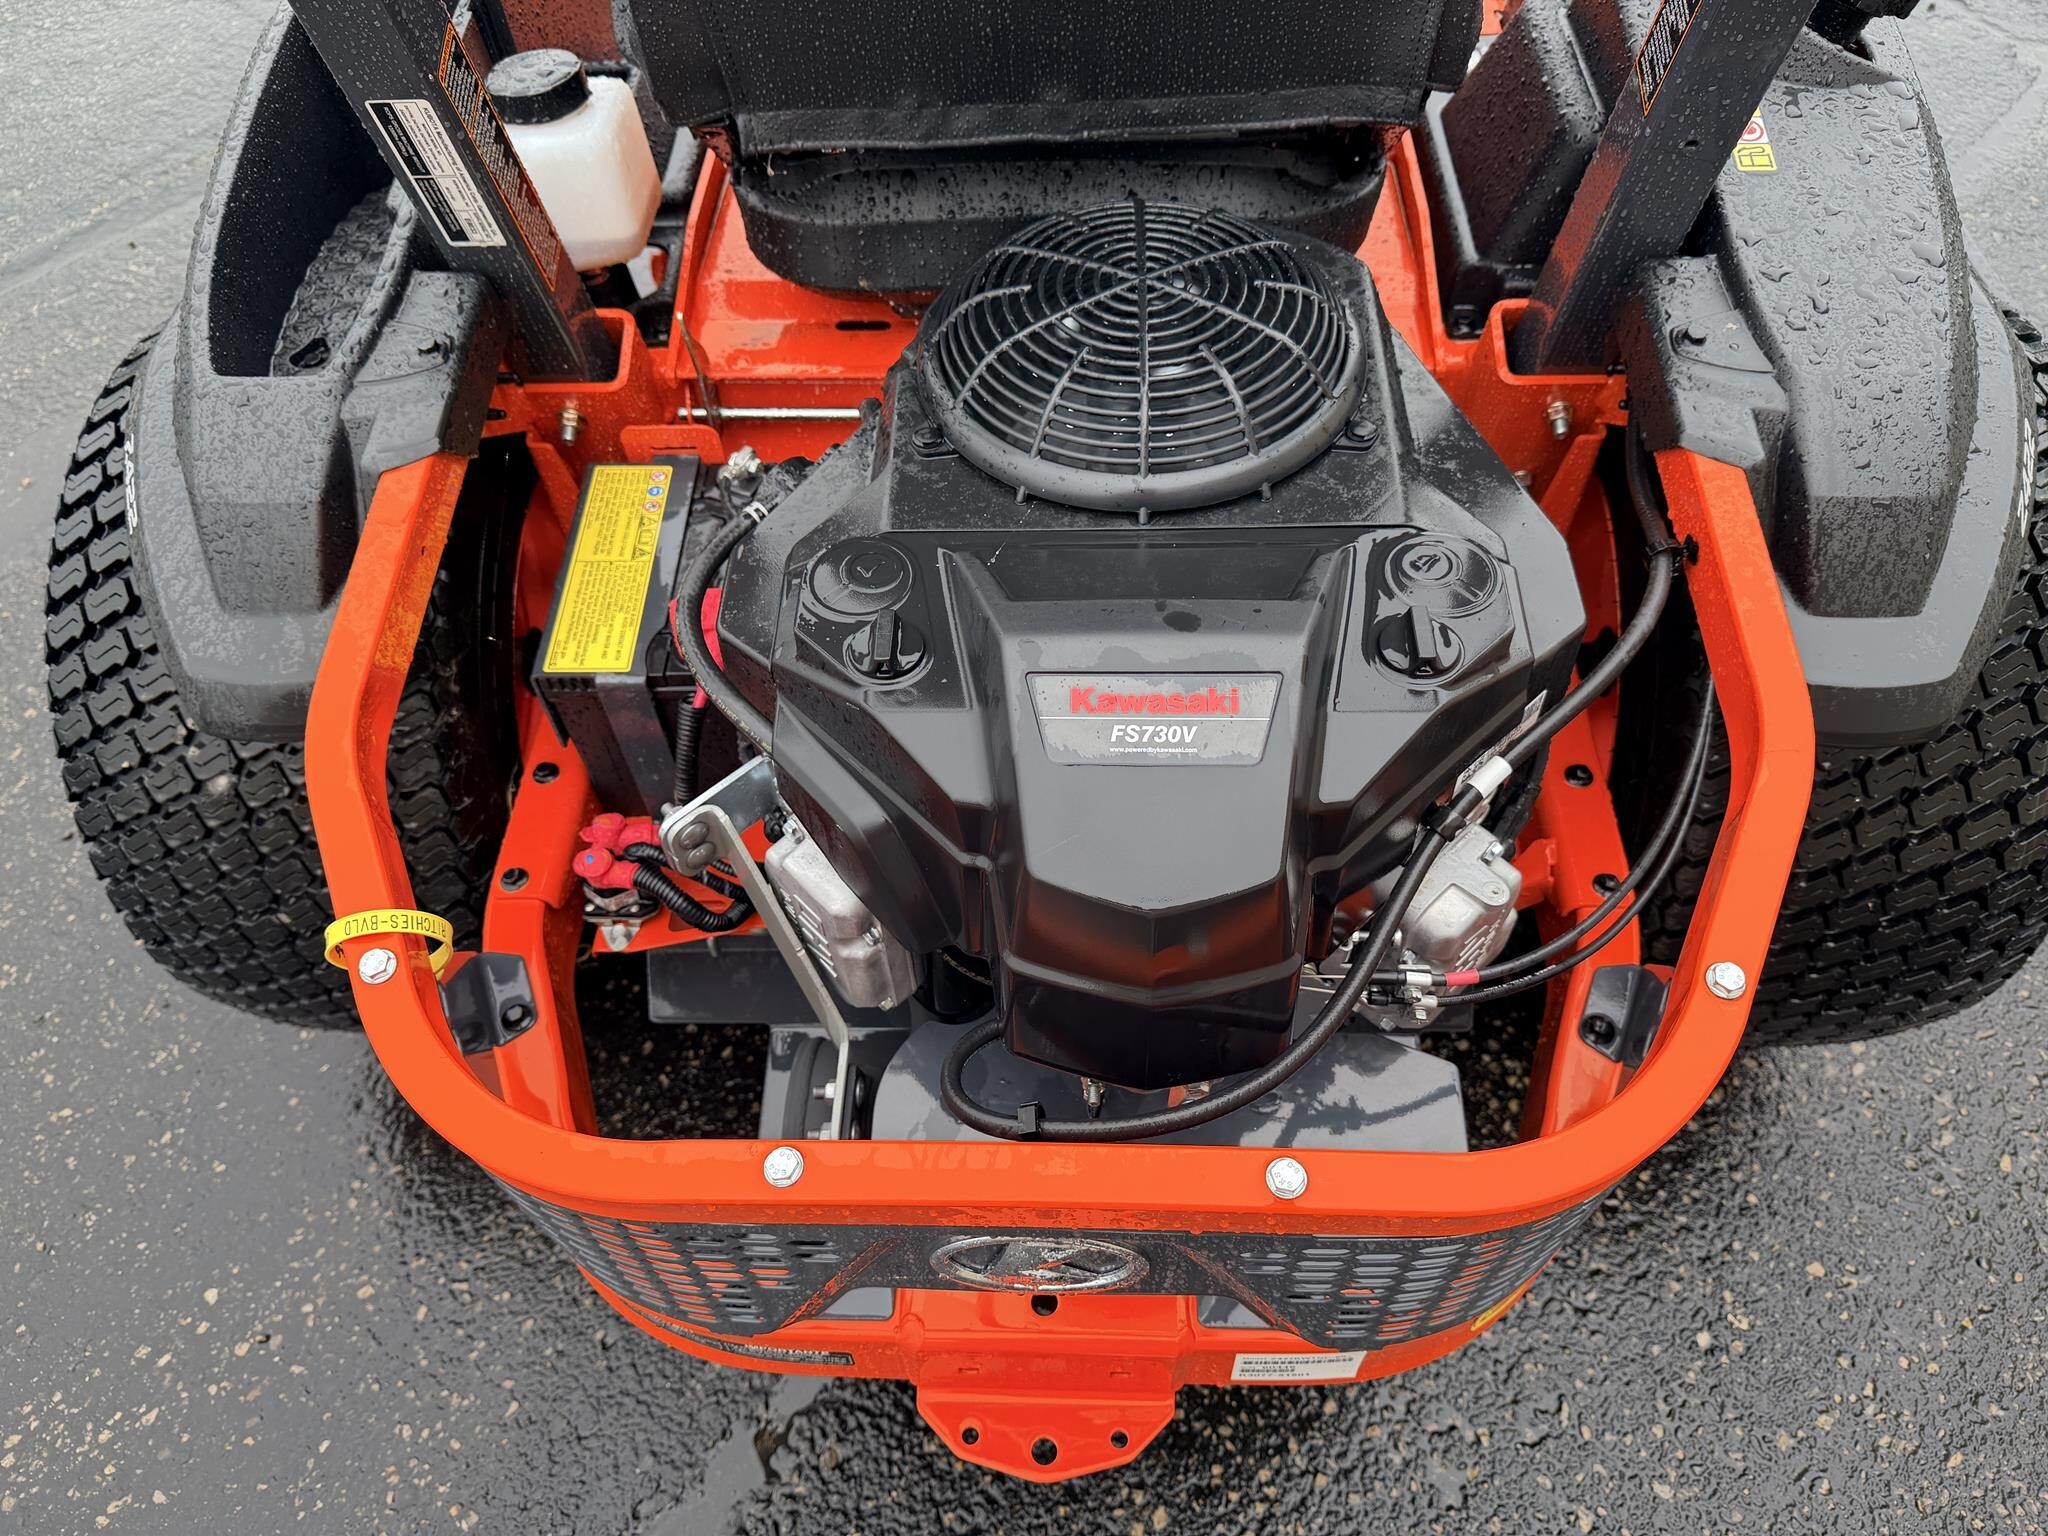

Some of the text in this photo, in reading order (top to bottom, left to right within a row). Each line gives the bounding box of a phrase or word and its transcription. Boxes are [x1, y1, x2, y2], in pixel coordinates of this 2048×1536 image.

[422, 107, 439, 129] KUBOTA
[1069, 686, 1240, 715] Kawasaki
[1109, 724, 1199, 743] FS730V
[1109, 746, 1198, 754] www.poweredbykawasaki.com
